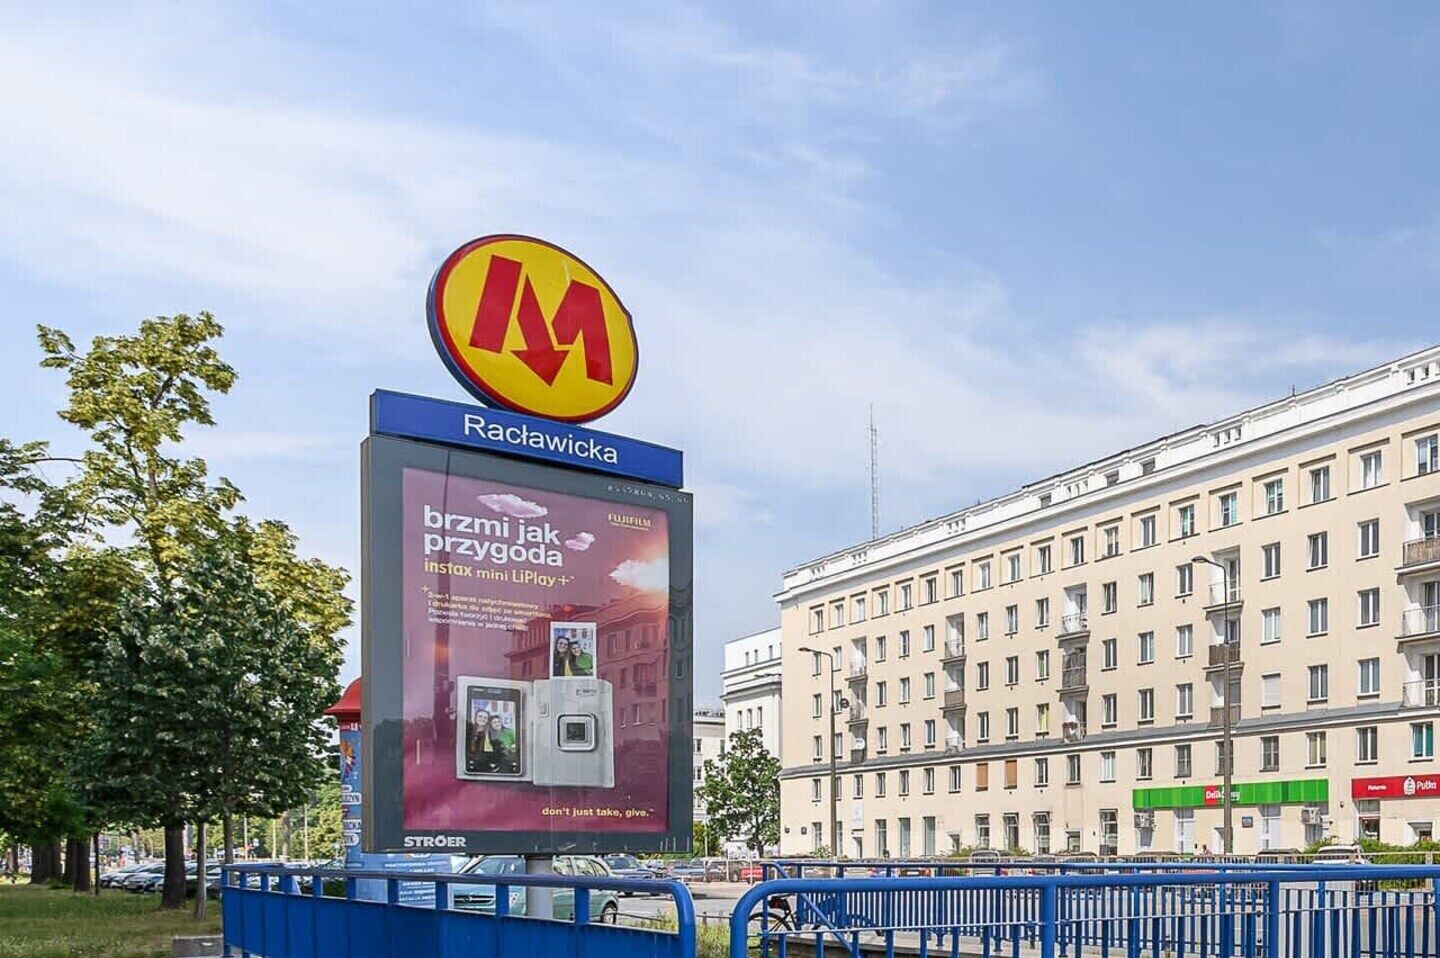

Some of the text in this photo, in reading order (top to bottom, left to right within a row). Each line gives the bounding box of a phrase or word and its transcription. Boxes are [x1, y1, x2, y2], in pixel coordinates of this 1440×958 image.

[464, 413, 618, 465] Racławicka
[423, 505, 561, 546] brzmi jak
[607, 513, 651, 528] FUJIFILM
[423, 533, 563, 567] przygoda
[424, 558, 472, 577] instax
[476, 568, 508, 581] mini
[541, 807, 570, 816] don't
[573, 807, 594, 817] just
[596, 807, 623, 818] take,
